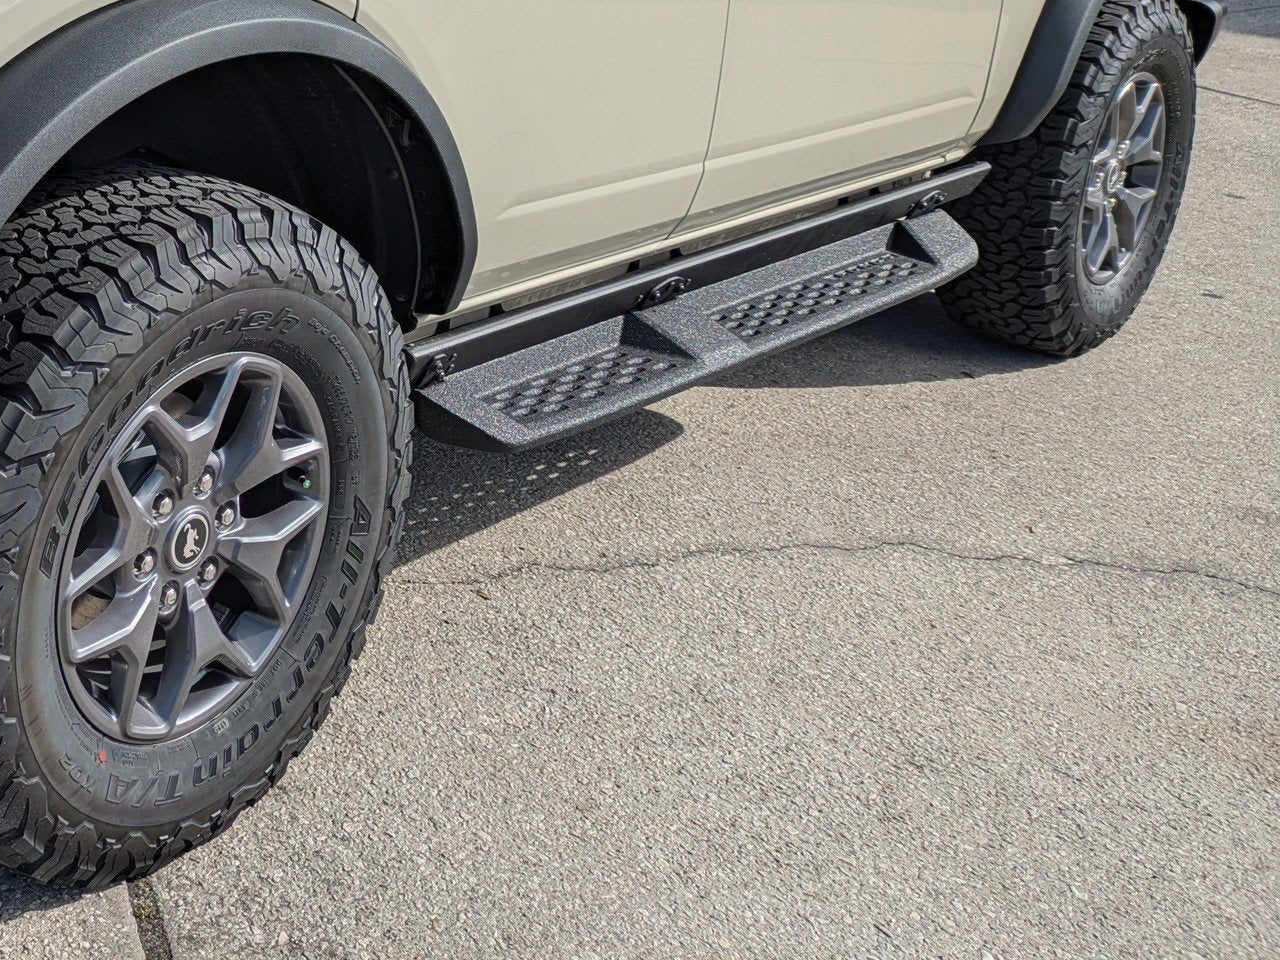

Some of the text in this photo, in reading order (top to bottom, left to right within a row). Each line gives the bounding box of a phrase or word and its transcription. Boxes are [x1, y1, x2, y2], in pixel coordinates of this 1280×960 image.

[39, 307, 301, 578] BFGoodrich
[192, 493, 372, 787] All-Terrain
[106, 772, 183, 808] T/A
